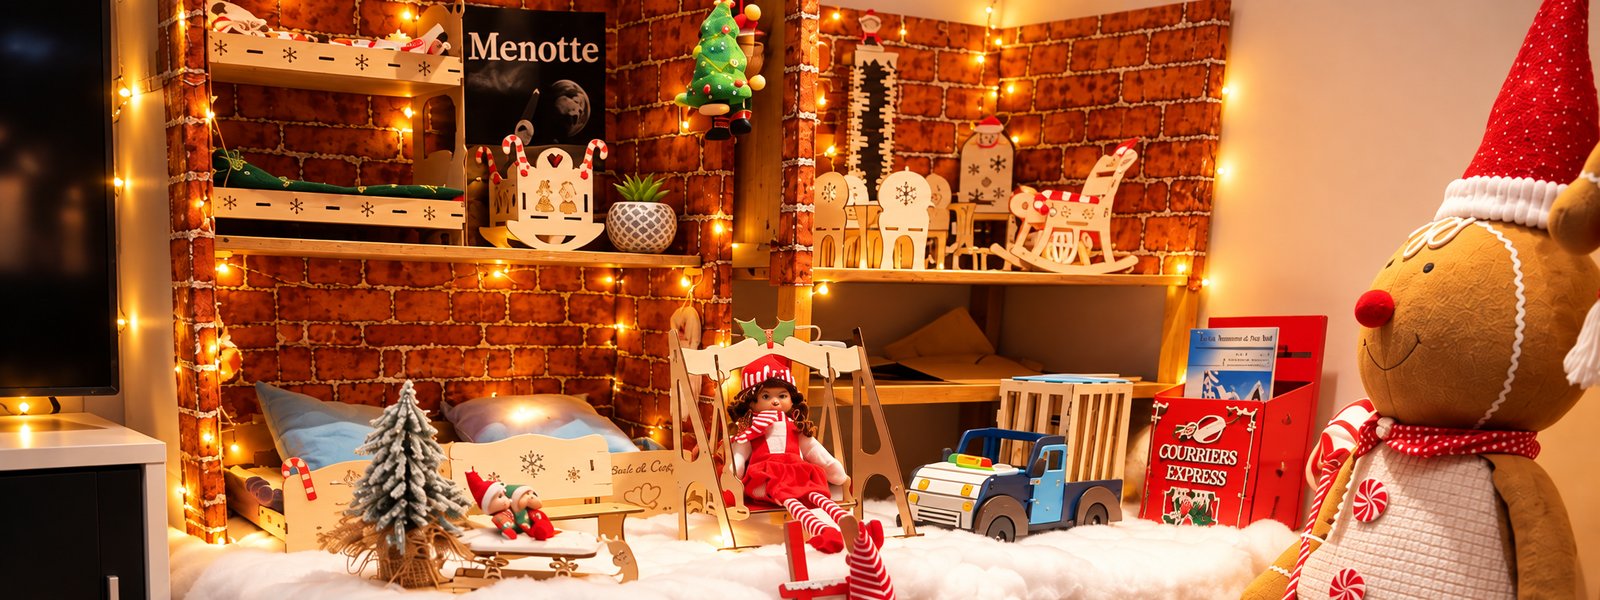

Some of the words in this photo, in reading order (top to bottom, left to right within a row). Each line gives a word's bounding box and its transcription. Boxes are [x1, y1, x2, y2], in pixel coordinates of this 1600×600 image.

[468, 32, 599, 63] Menotte
[1159, 443, 1238, 466] COURRIERS
[1165, 464, 1227, 486] EXPRESS
